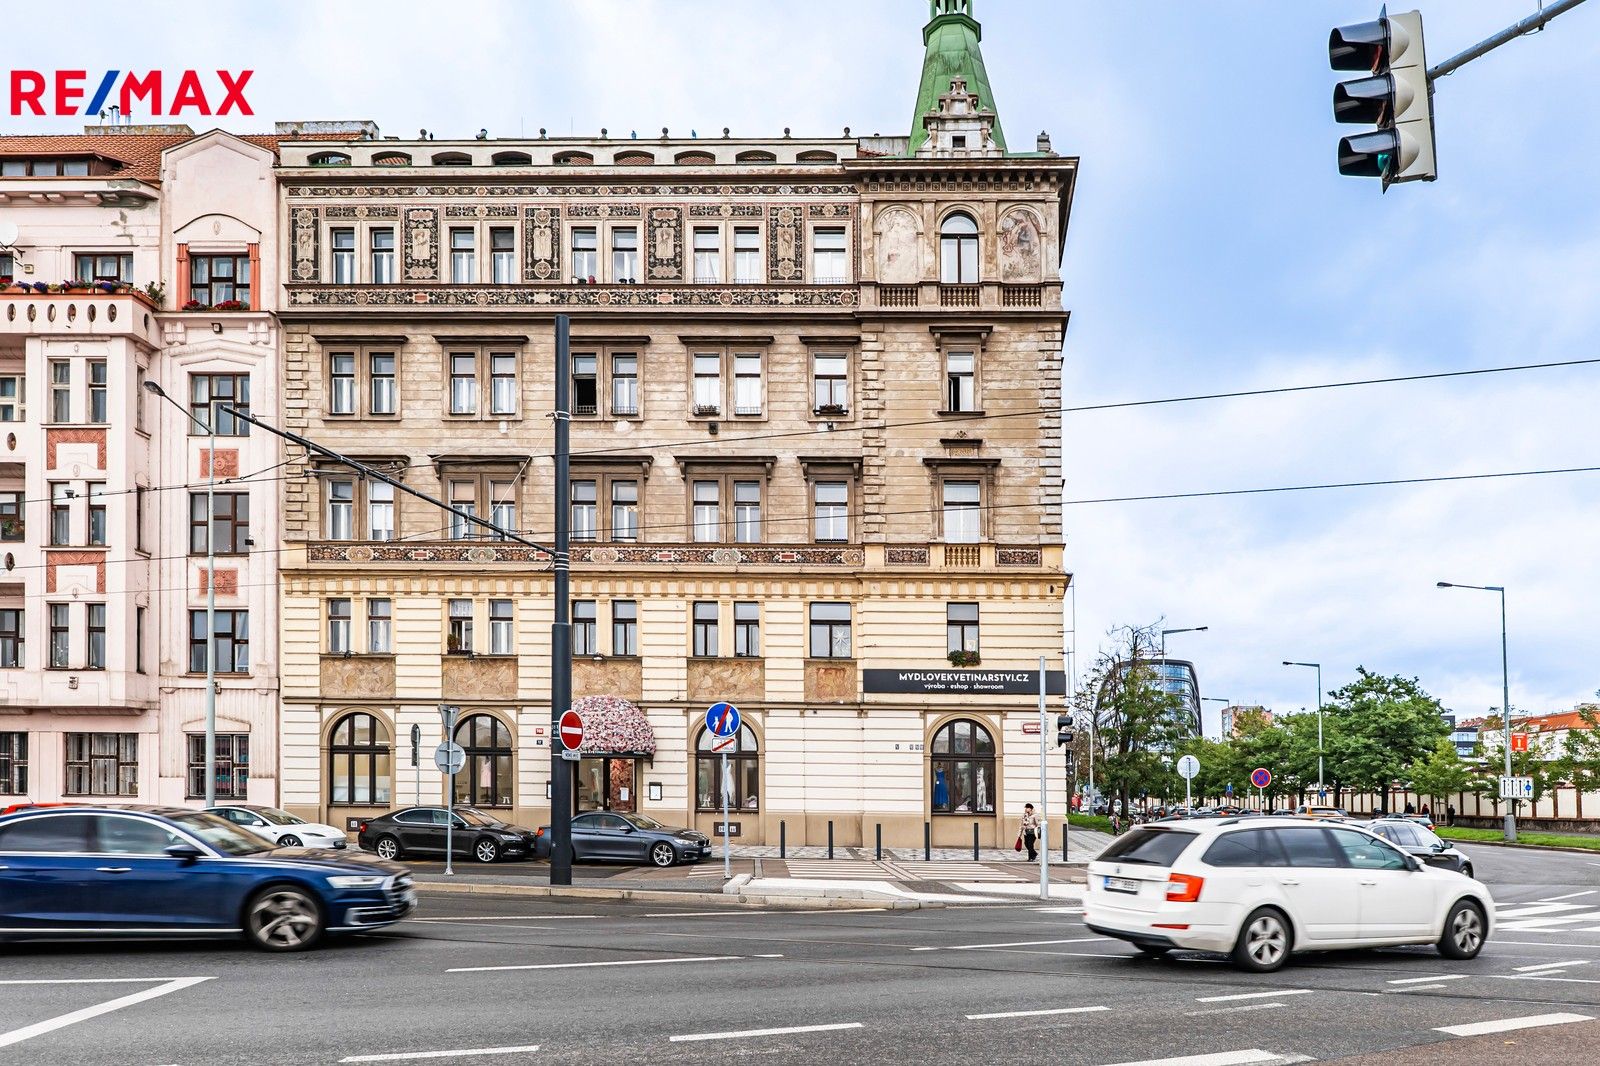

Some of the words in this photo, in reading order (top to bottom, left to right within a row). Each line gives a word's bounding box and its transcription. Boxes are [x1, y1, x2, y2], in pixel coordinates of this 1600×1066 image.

[898, 672, 1030, 682] MYDLOVEKVETINARSTVI.CZ
[923, 682, 946, 690] výroba
[950, 682, 969, 691] eshop
